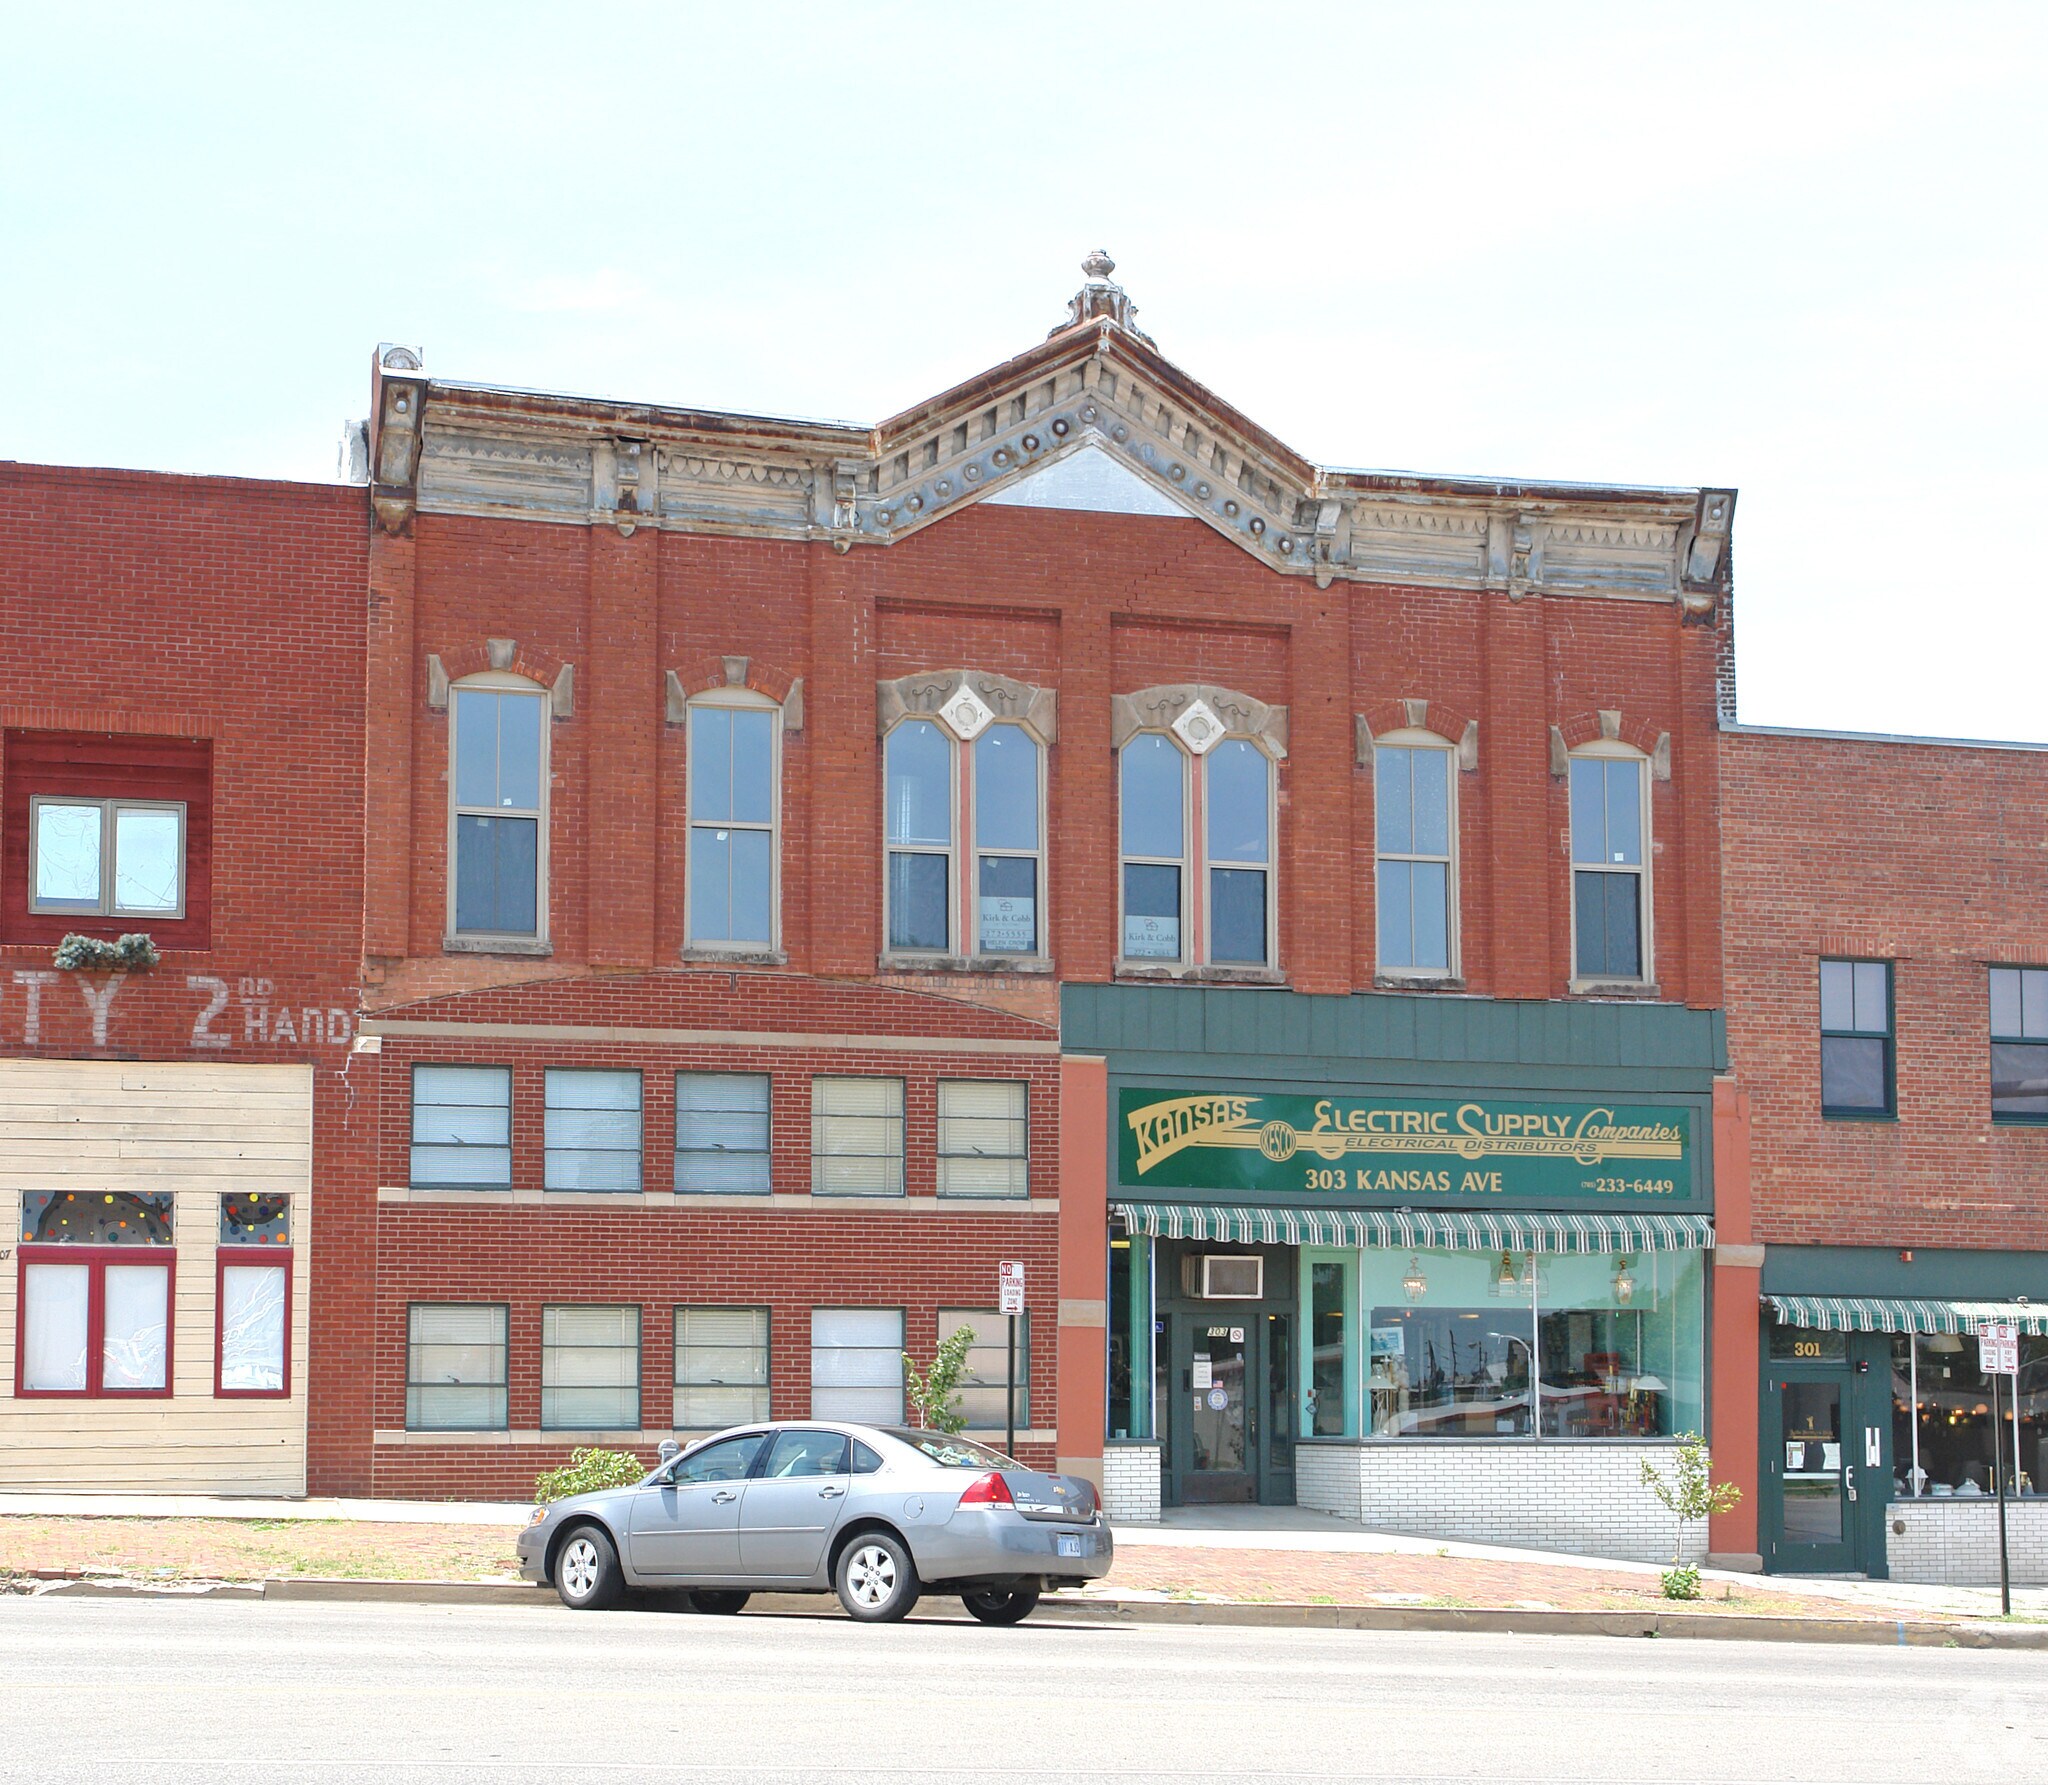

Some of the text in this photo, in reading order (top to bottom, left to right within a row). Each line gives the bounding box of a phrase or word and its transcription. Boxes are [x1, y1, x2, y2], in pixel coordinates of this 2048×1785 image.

[1011, 914, 1031, 922] Cobb
[1128, 933, 1145, 941] Kirk
[1156, 934, 1176, 942] Cobb
[0, 970, 128, 1046] TY
[244, 1006, 351, 1044] HAND
[1130, 1099, 1249, 1163] KANSAS
[1312, 1101, 1448, 1160] ELECTRIC
[1456, 1104, 1572, 1160] SUPPLY
[1573, 1108, 1682, 1166] Companies
[1345, 1137, 1598, 1153] ELECTRICAL DISTRIBUTORS
[1305, 1169, 1503, 1192] 303 KANSAS AVE
[1001, 1264, 1012, 1275] NO
[1001, 1277, 1023, 1287] PARKING
[1208, 1327, 1227, 1336] 303
[1980, 1326, 1989, 1336] NO
[1999, 1327, 2007, 1337] NO
[1980, 1338, 1998, 1348] PARKING
[1999, 1339, 2017, 1349] PARKING
[1794, 1341, 1821, 1357] 301
